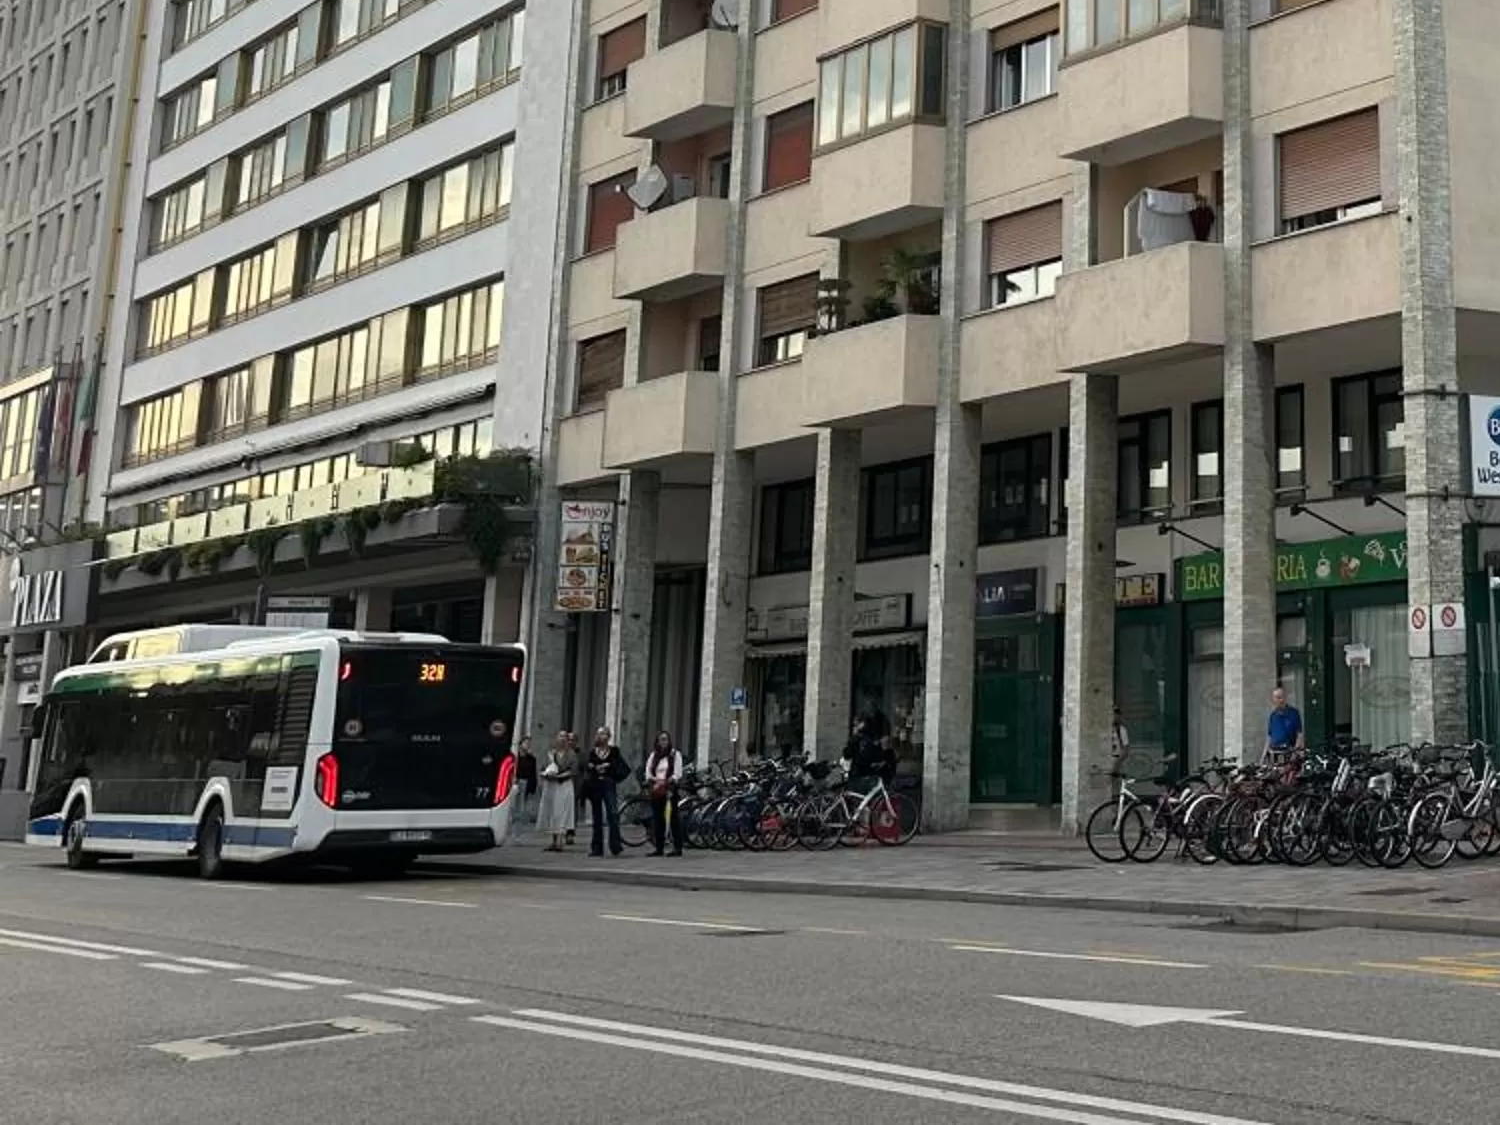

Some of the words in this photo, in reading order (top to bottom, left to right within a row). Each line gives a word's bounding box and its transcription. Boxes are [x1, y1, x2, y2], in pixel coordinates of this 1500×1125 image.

[1184, 562, 1221, 591] BAR
[1276, 554, 1307, 582] RIA
[11, 570, 63, 627] PLAZA
[475, 786, 490, 798] 77
